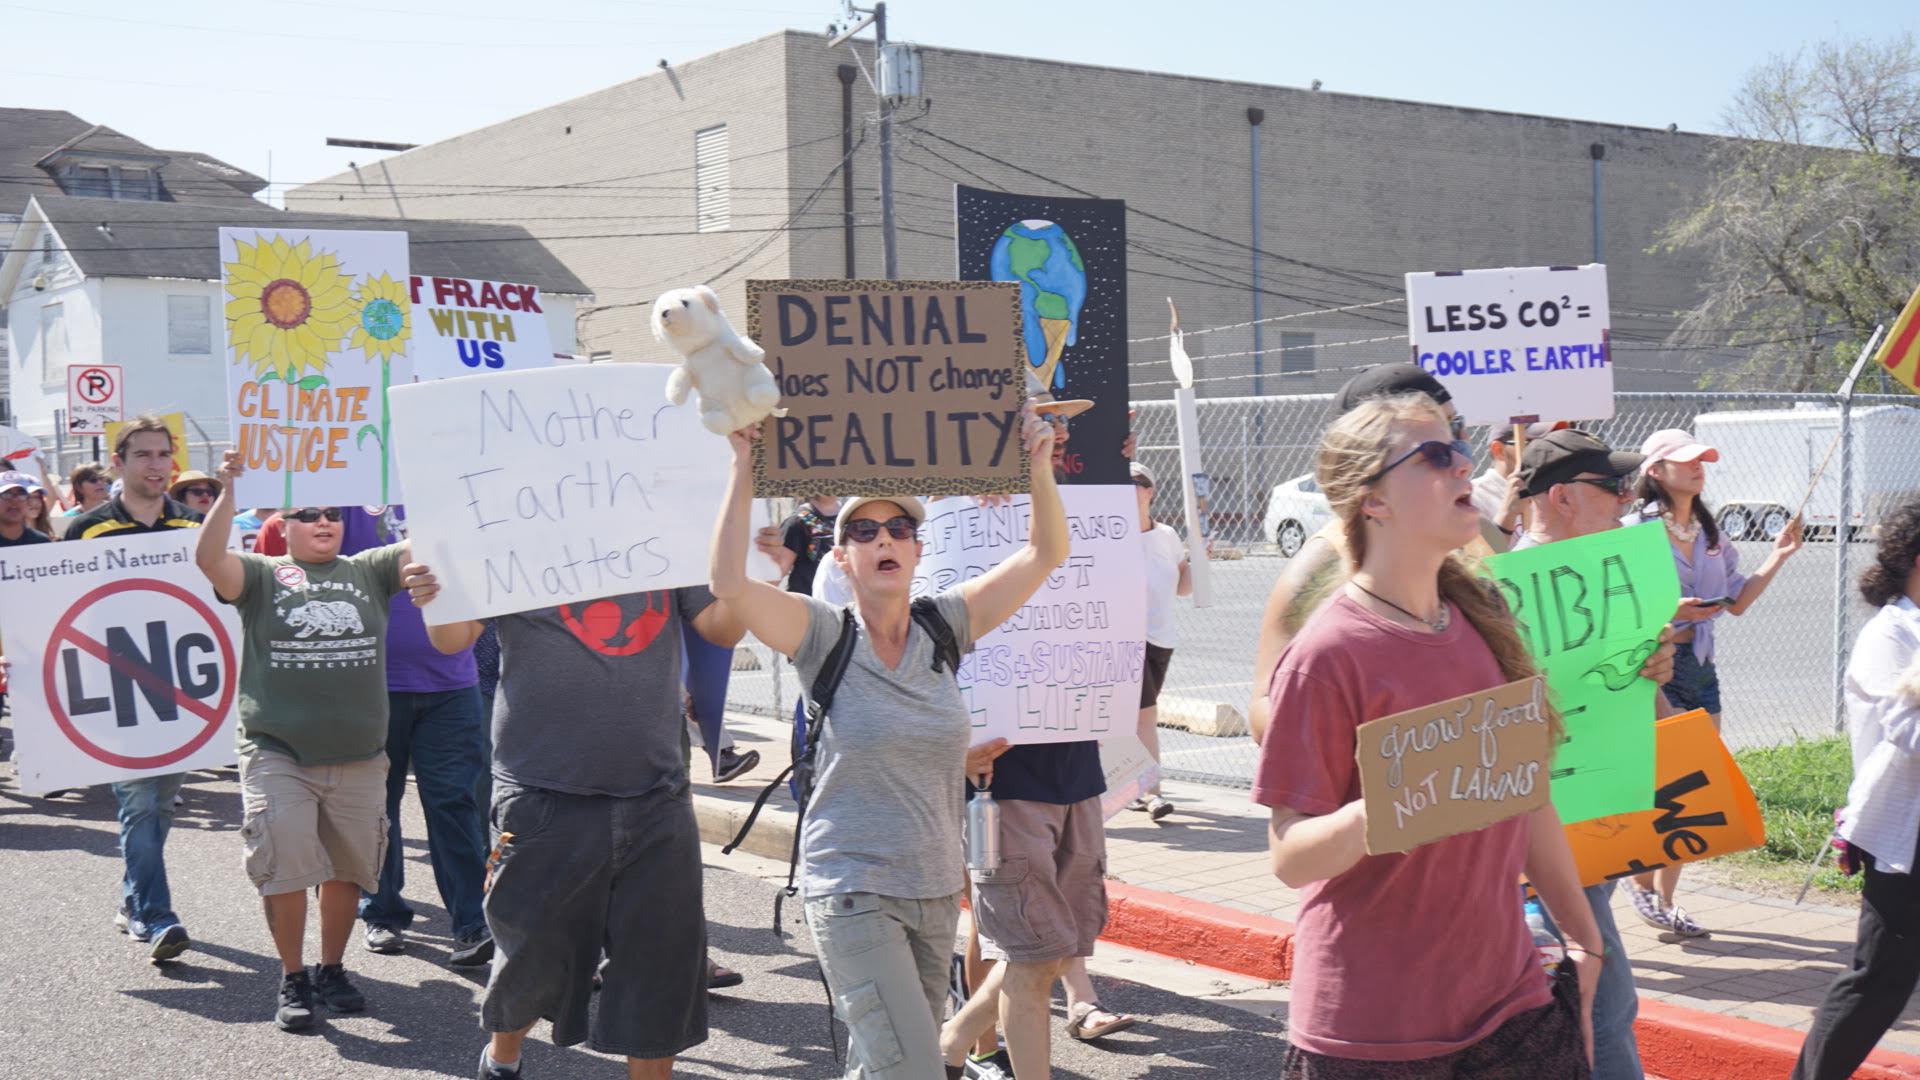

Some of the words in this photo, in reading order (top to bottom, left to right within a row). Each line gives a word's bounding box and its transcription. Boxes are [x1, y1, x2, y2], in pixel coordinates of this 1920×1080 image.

[432, 277, 543, 313] FRACK
[428, 308, 516, 342] WITH
[777, 294, 987, 346] DENIAL
[1425, 303, 1508, 333] LESS
[456, 338, 505, 369] US
[1420, 348, 1516, 377] COOLER
[1524, 343, 1605, 371] EARTH
[846, 356, 923, 394] NOT
[929, 357, 1014, 400] change
[238, 380, 370, 422] CLIMATE
[480, 387, 675, 456] Mother
[237, 423, 349, 473] JUSTICE
[776, 410, 1017, 469] REALITY
[458, 459, 654, 532] Earth
[1067, 515, 1129, 540] AND
[0, 556, 99, 582] Liquefied
[105, 547, 189, 570] Natural
[486, 537, 670, 605] Matters
[1000, 601, 1110, 634] WHICH
[62, 620, 220, 728] LNG
[1016, 684, 1115, 732] LIFE
[1380, 698, 1473, 789] grow
[1471, 678, 1546, 769] food
[1449, 760, 1540, 802] LAWNS
[1652, 770, 1729, 861] We
